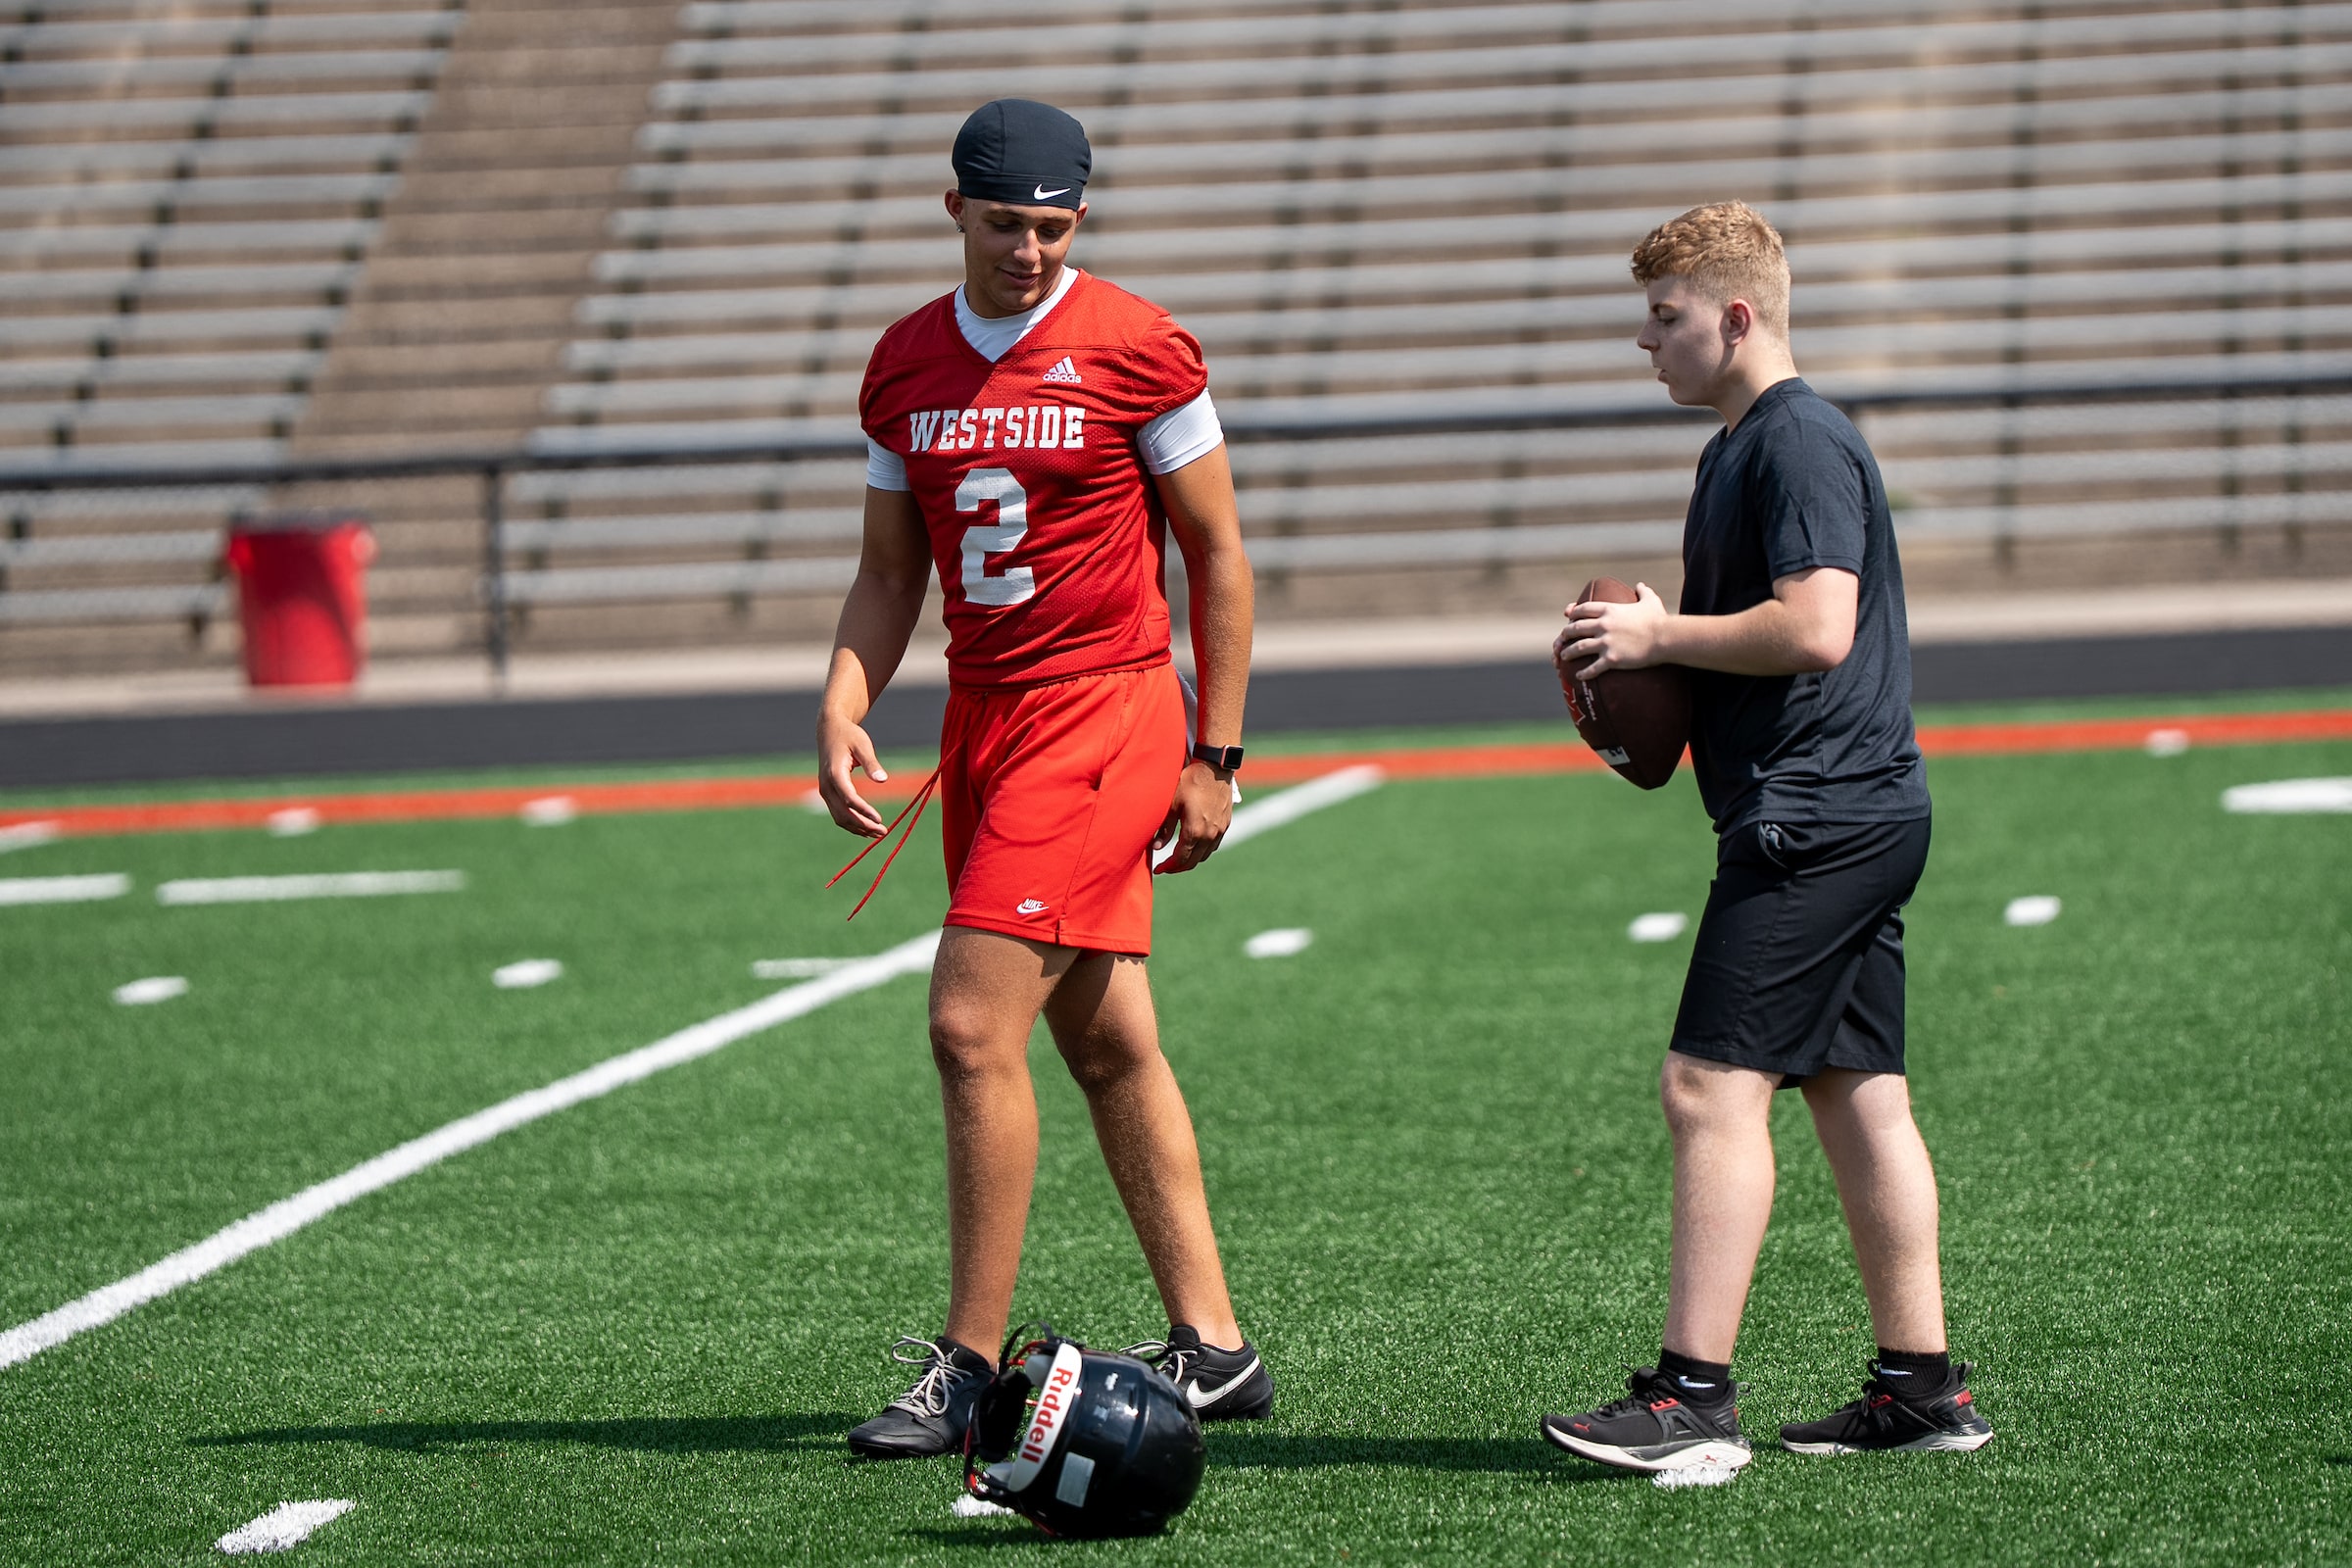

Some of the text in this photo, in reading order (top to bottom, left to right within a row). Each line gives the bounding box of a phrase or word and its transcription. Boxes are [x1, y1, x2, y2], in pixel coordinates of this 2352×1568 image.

[1043, 372, 1082, 383] adidas
[909, 406, 1086, 452] WESTSIDE
[955, 467, 1036, 606] 2
[1022, 898, 1045, 910] NIKE
[1021, 1367, 1073, 1463] Riddell
